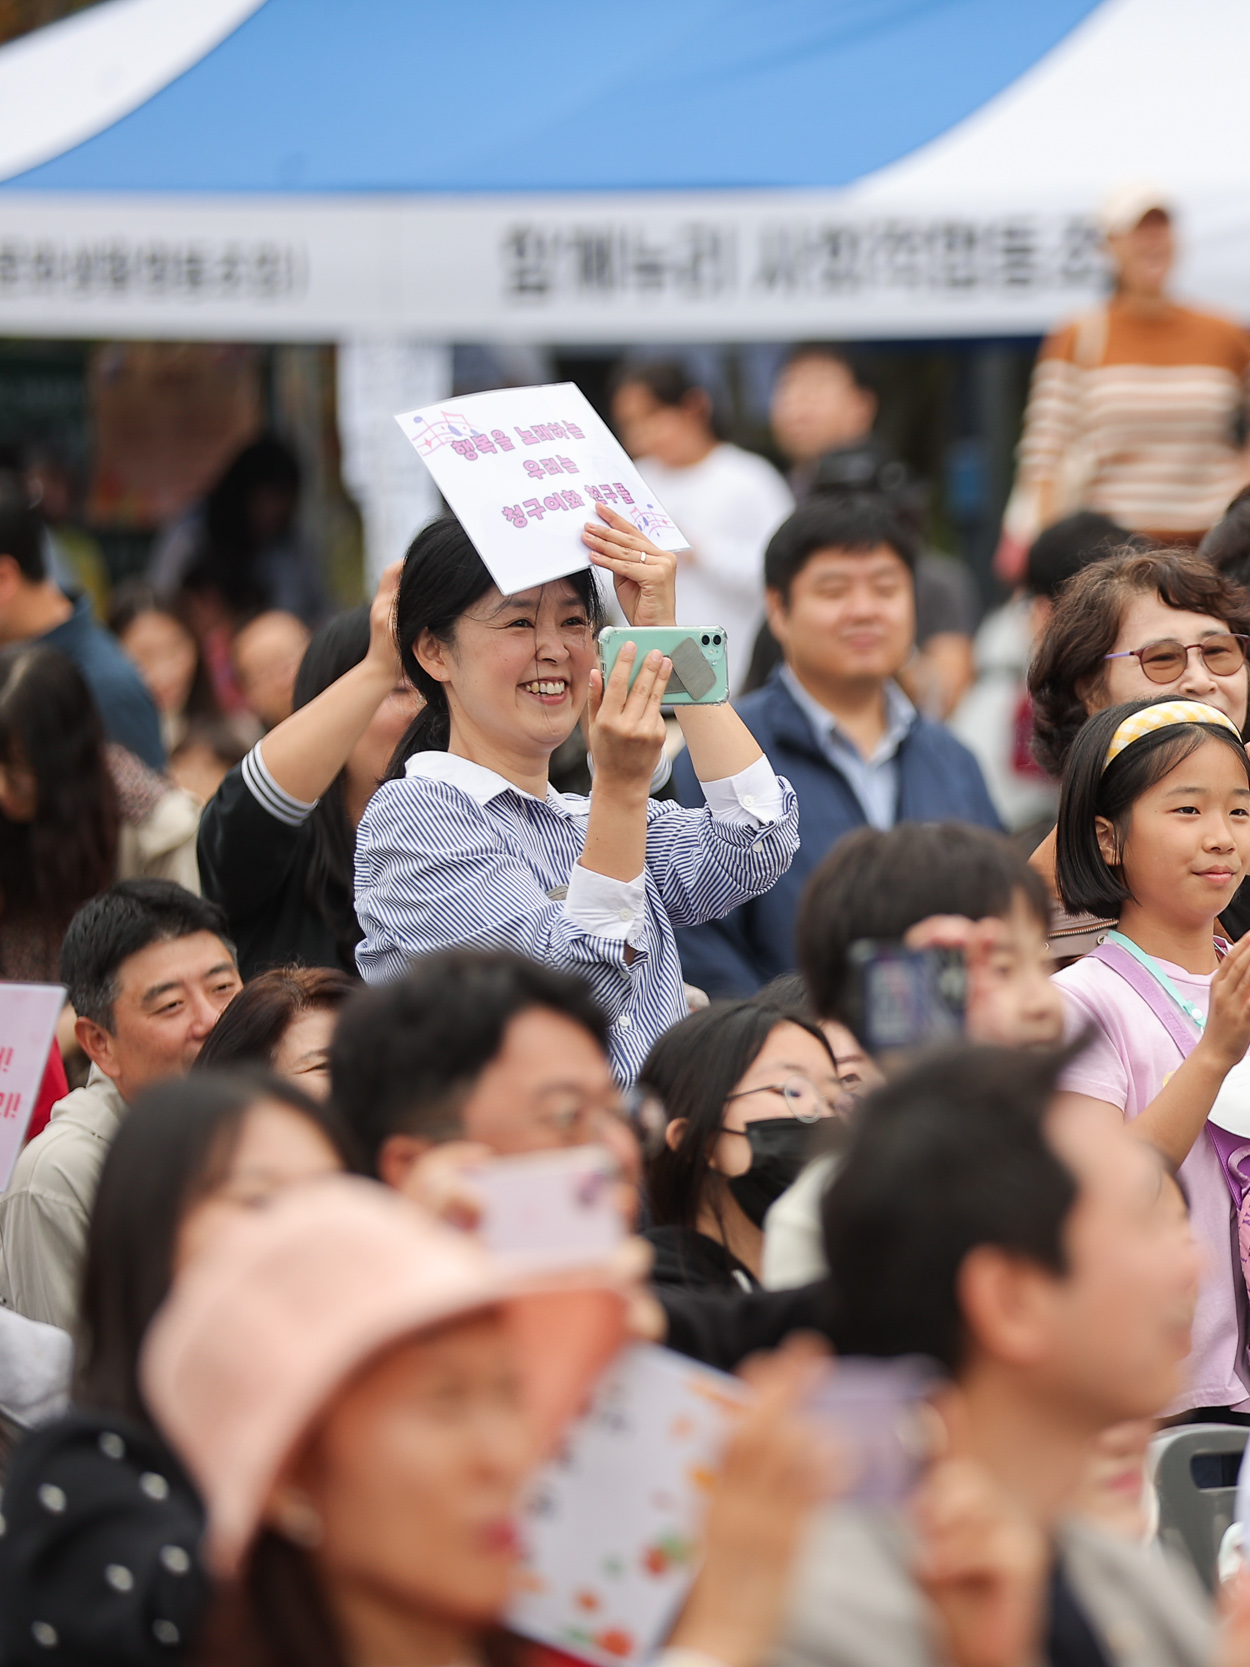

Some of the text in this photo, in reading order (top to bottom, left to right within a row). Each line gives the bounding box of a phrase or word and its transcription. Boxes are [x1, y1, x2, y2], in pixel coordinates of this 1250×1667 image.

[450, 420, 586, 461] 행복을 노래하는
[523, 454, 581, 480] 우리는
[501, 489, 586, 529] 청구이화
